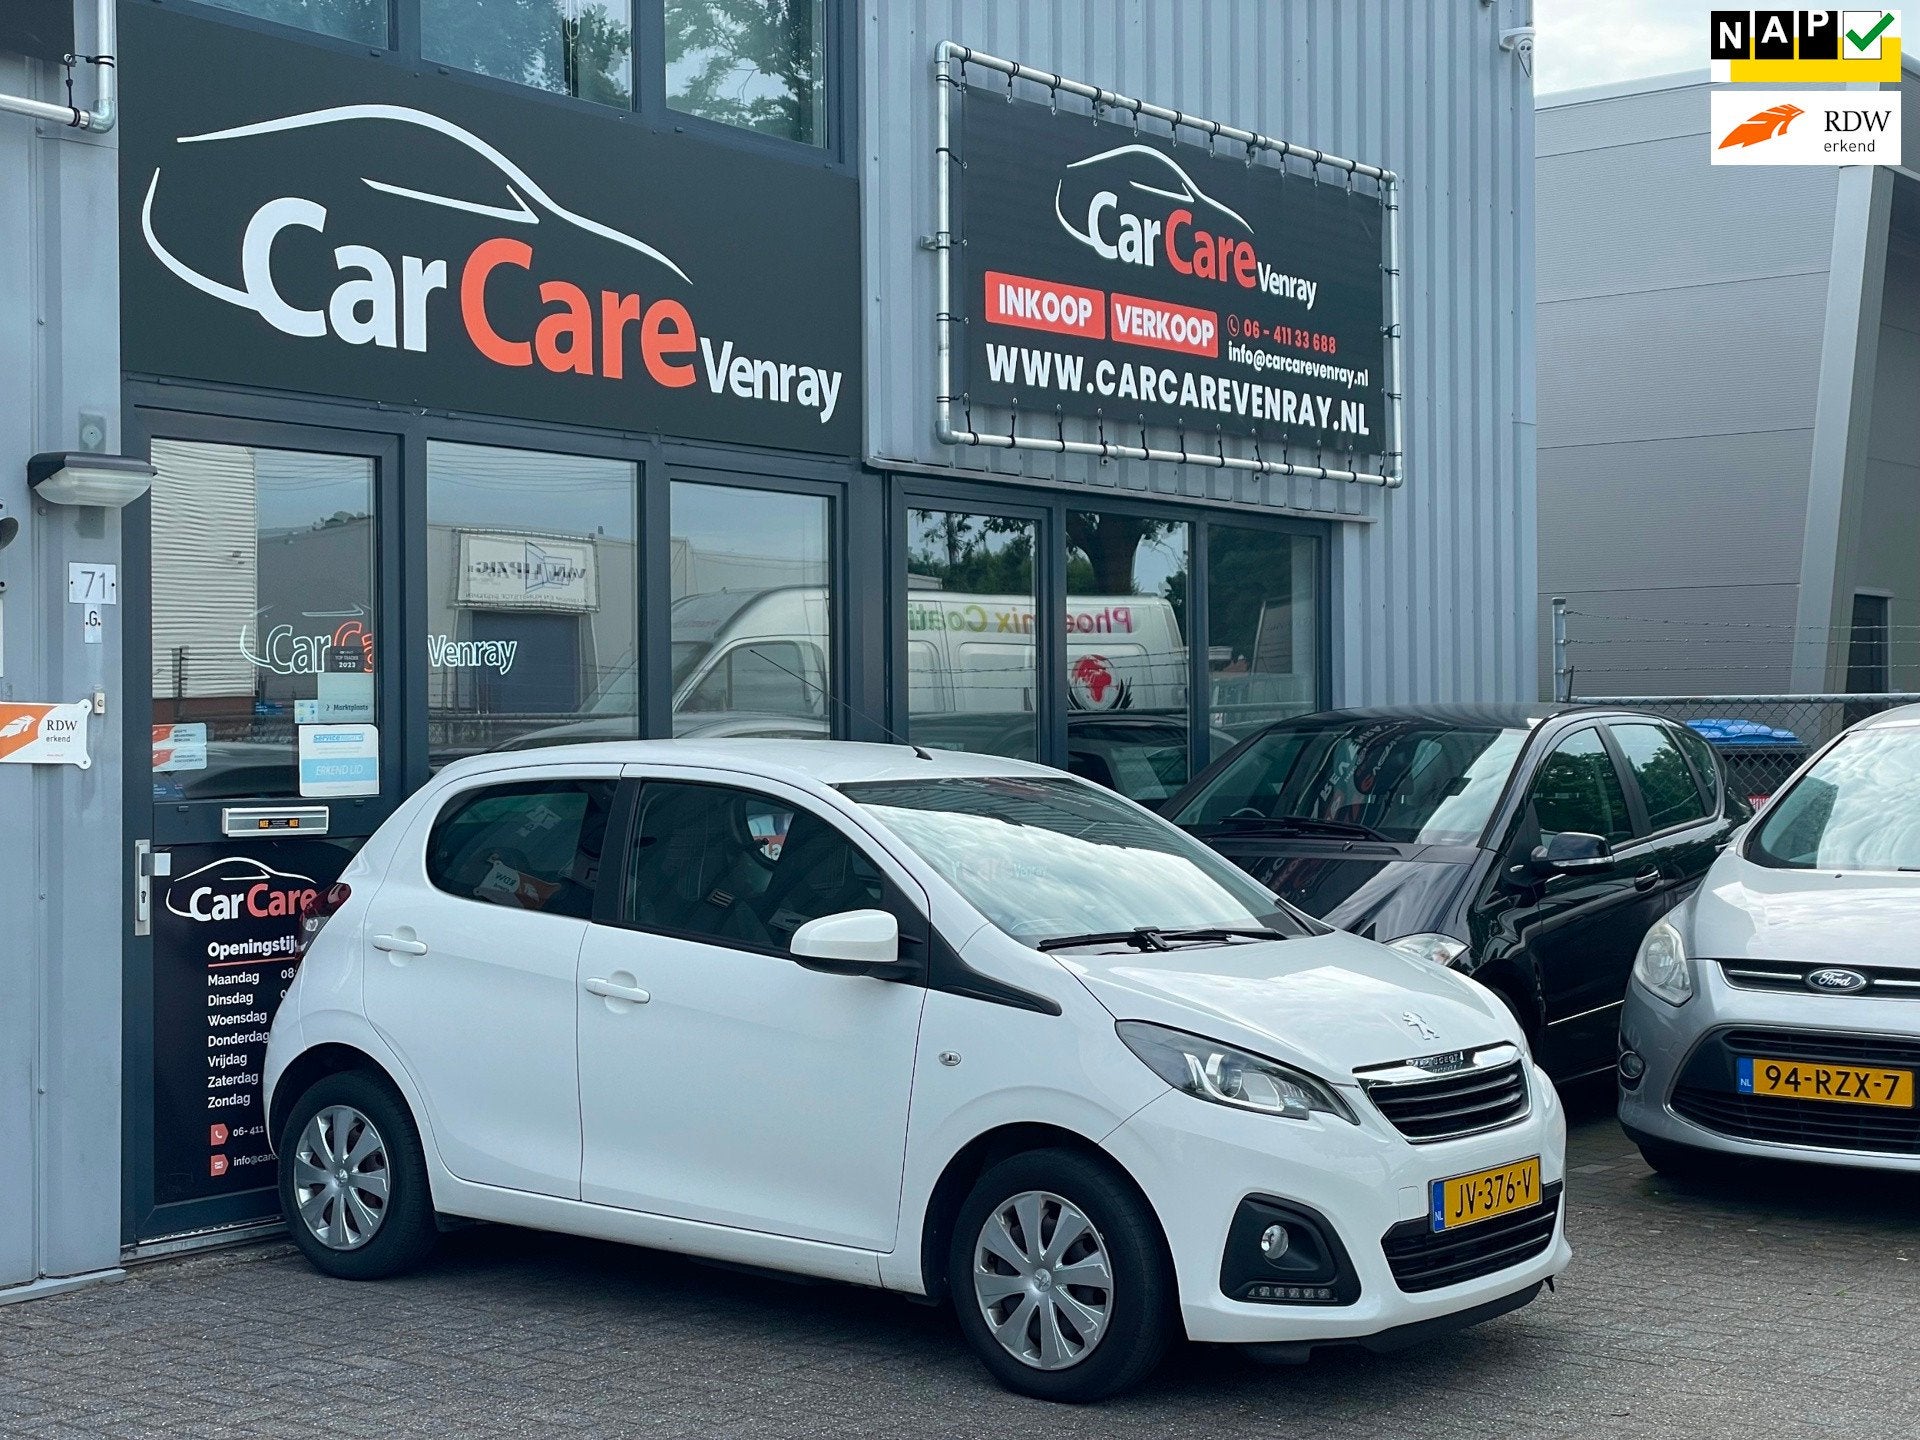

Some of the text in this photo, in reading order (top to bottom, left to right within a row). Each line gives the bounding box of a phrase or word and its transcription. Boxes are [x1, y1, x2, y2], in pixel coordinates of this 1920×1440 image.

[1257, 261, 1318, 311] Venray
[999, 283, 1093, 327] INKOOP
[1115, 303, 1215, 347] VERKOOP
[1243, 318, 1260, 339] 06
[1273, 325, 1292, 346] 411
[1295, 329, 1310, 349] 33
[1312, 333, 1337, 354] 688
[1228, 341, 1369, 389] info@carcarevenray.nl
[699, 336, 842, 424] Venray
[985, 342, 1370, 436] WWW.CARCAREVENRAY.NL
[81, 570, 106, 599] 71
[428, 633, 517, 675] Venray
[46, 719, 78, 731] RDW
[46, 735, 71, 743] erkend
[207, 935, 297, 961] Openingstij
[207, 970, 260, 987] Maandag
[1818, 972, 1851, 988] Ford
[207, 991, 254, 1008] Dinsdag
[207, 1010, 267, 1027] Woensdag
[207, 1030, 270, 1048] Donderdag
[207, 1053, 248, 1069] Vrijdag
[207, 1071, 259, 1089] Zaterdag
[1740, 1064, 1900, 1101] NL 94-RZX-7
[207, 1092, 251, 1109] Zondag
[1434, 1165, 1533, 1222] NL JV-376-V
